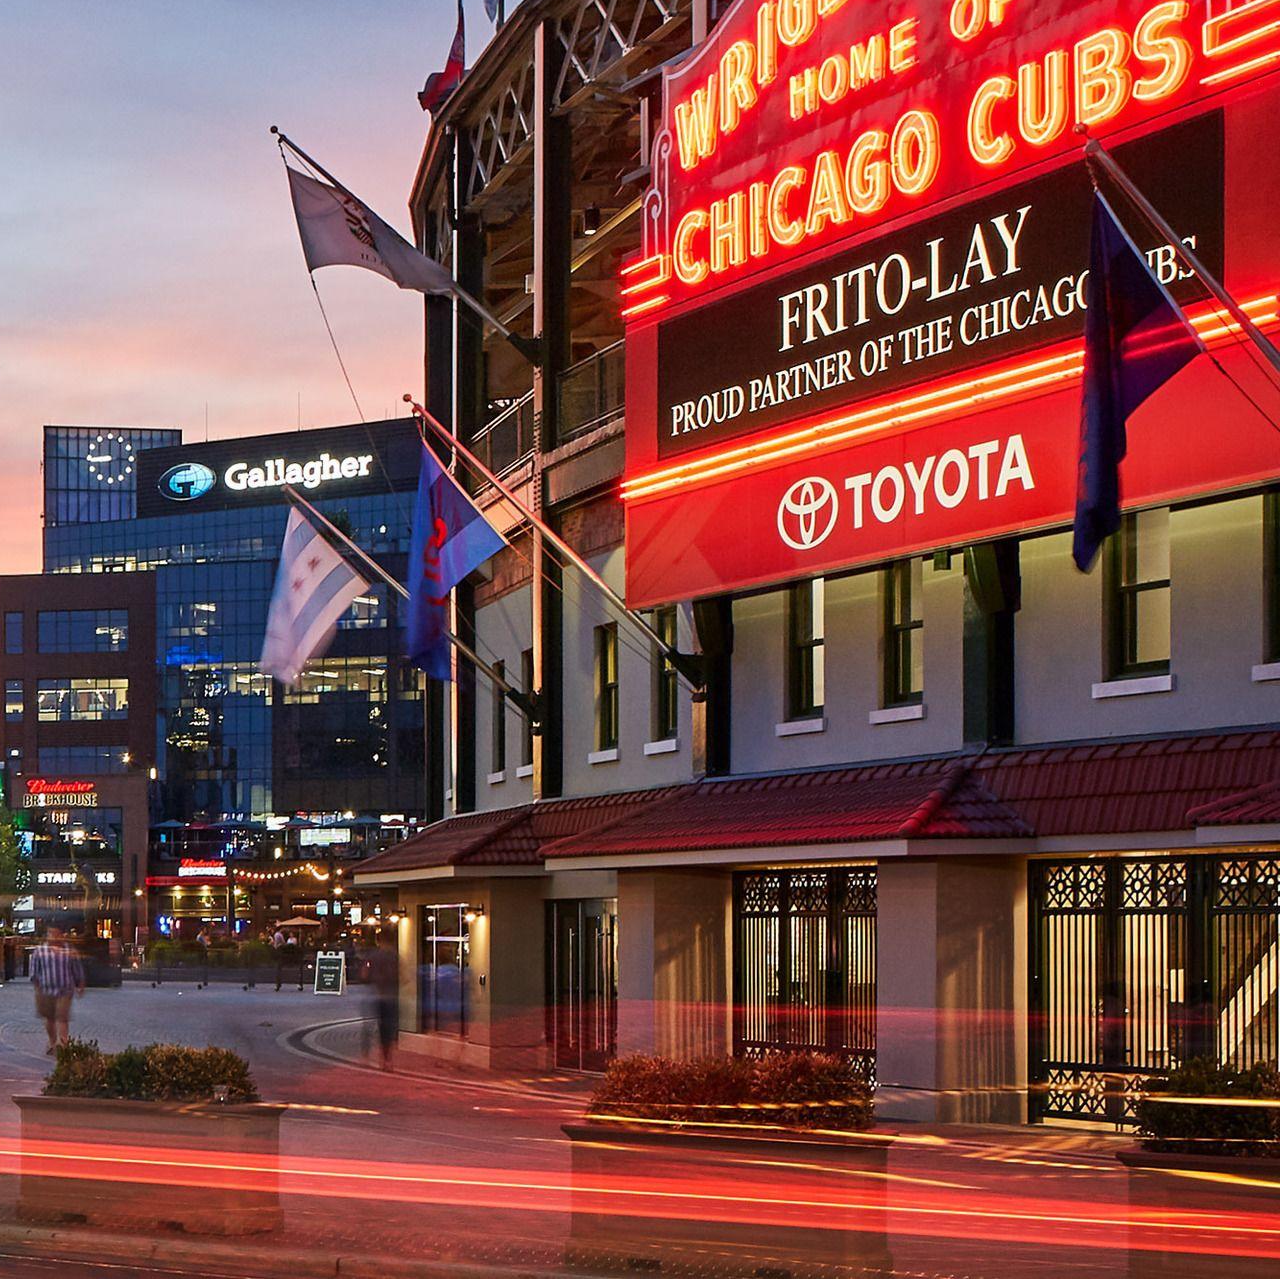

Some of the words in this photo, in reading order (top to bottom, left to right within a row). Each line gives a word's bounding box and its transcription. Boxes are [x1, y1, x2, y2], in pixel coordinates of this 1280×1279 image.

[790, 17, 921, 121] HOME
[673, 109, 940, 284] CHICAGO
[967, 0, 1192, 165] CUBS
[778, 205, 1032, 353] FRITO-LAY
[670, 384, 745, 437] PROUD
[749, 349, 855, 413] PARTNER
[859, 334, 894, 377] OF
[899, 315, 954, 365] THE
[224, 453, 373, 490] Gallagher
[844, 433, 1036, 529] TOYOTA
[23, 792, 97, 808] BRCKHOUSE
[26, 779, 95, 793] Budweiser
[37, 872, 116, 884] STARKS
